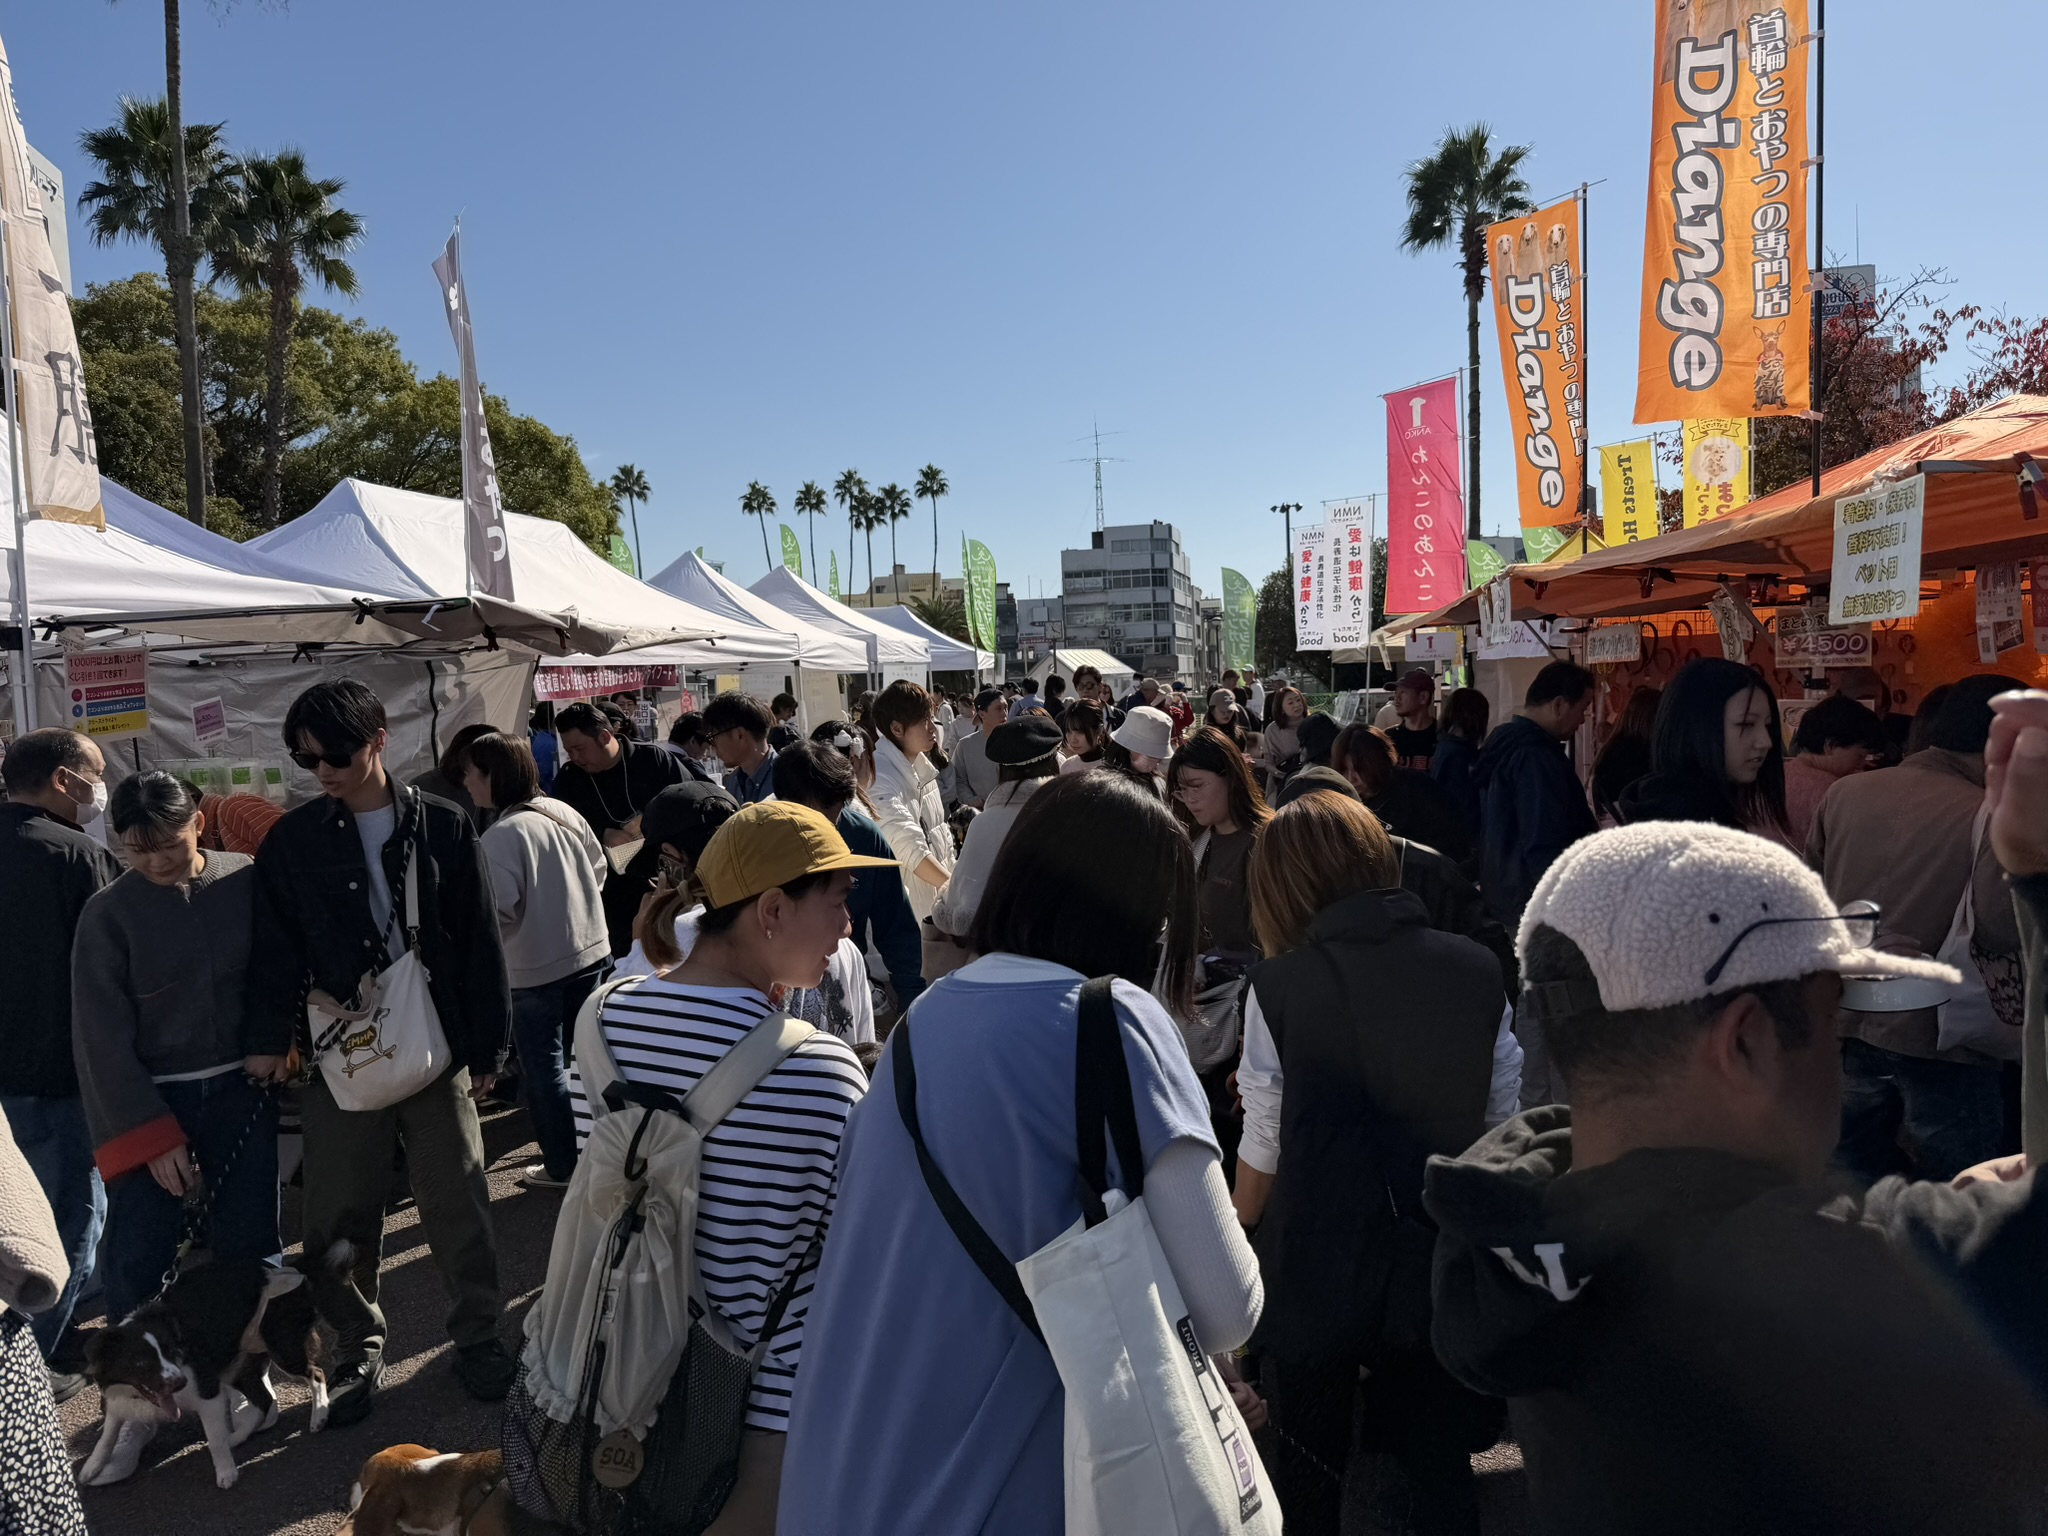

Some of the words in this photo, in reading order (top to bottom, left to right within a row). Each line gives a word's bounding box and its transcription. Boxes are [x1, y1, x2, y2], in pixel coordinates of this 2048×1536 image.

[1747, 7, 1791, 319] 首輪とおやつの専門店
[1657, 30, 1740, 391] Diange
[1505, 273, 1565, 508] Diange
[1617, 454, 1636, 514] Treats
[1301, 531, 1324, 541] NMN
[1855, 556, 1898, 583] ペット用
[1842, 590, 1906, 617] 無添加おやつ
[1299, 636, 1324, 646] Good
[1783, 633, 1866, 653] ¥4500
[346, 1029, 374, 1049] EMMA
[1181, 1325, 1206, 1370] FRONT
[600, 1447, 637, 1471] SOA
